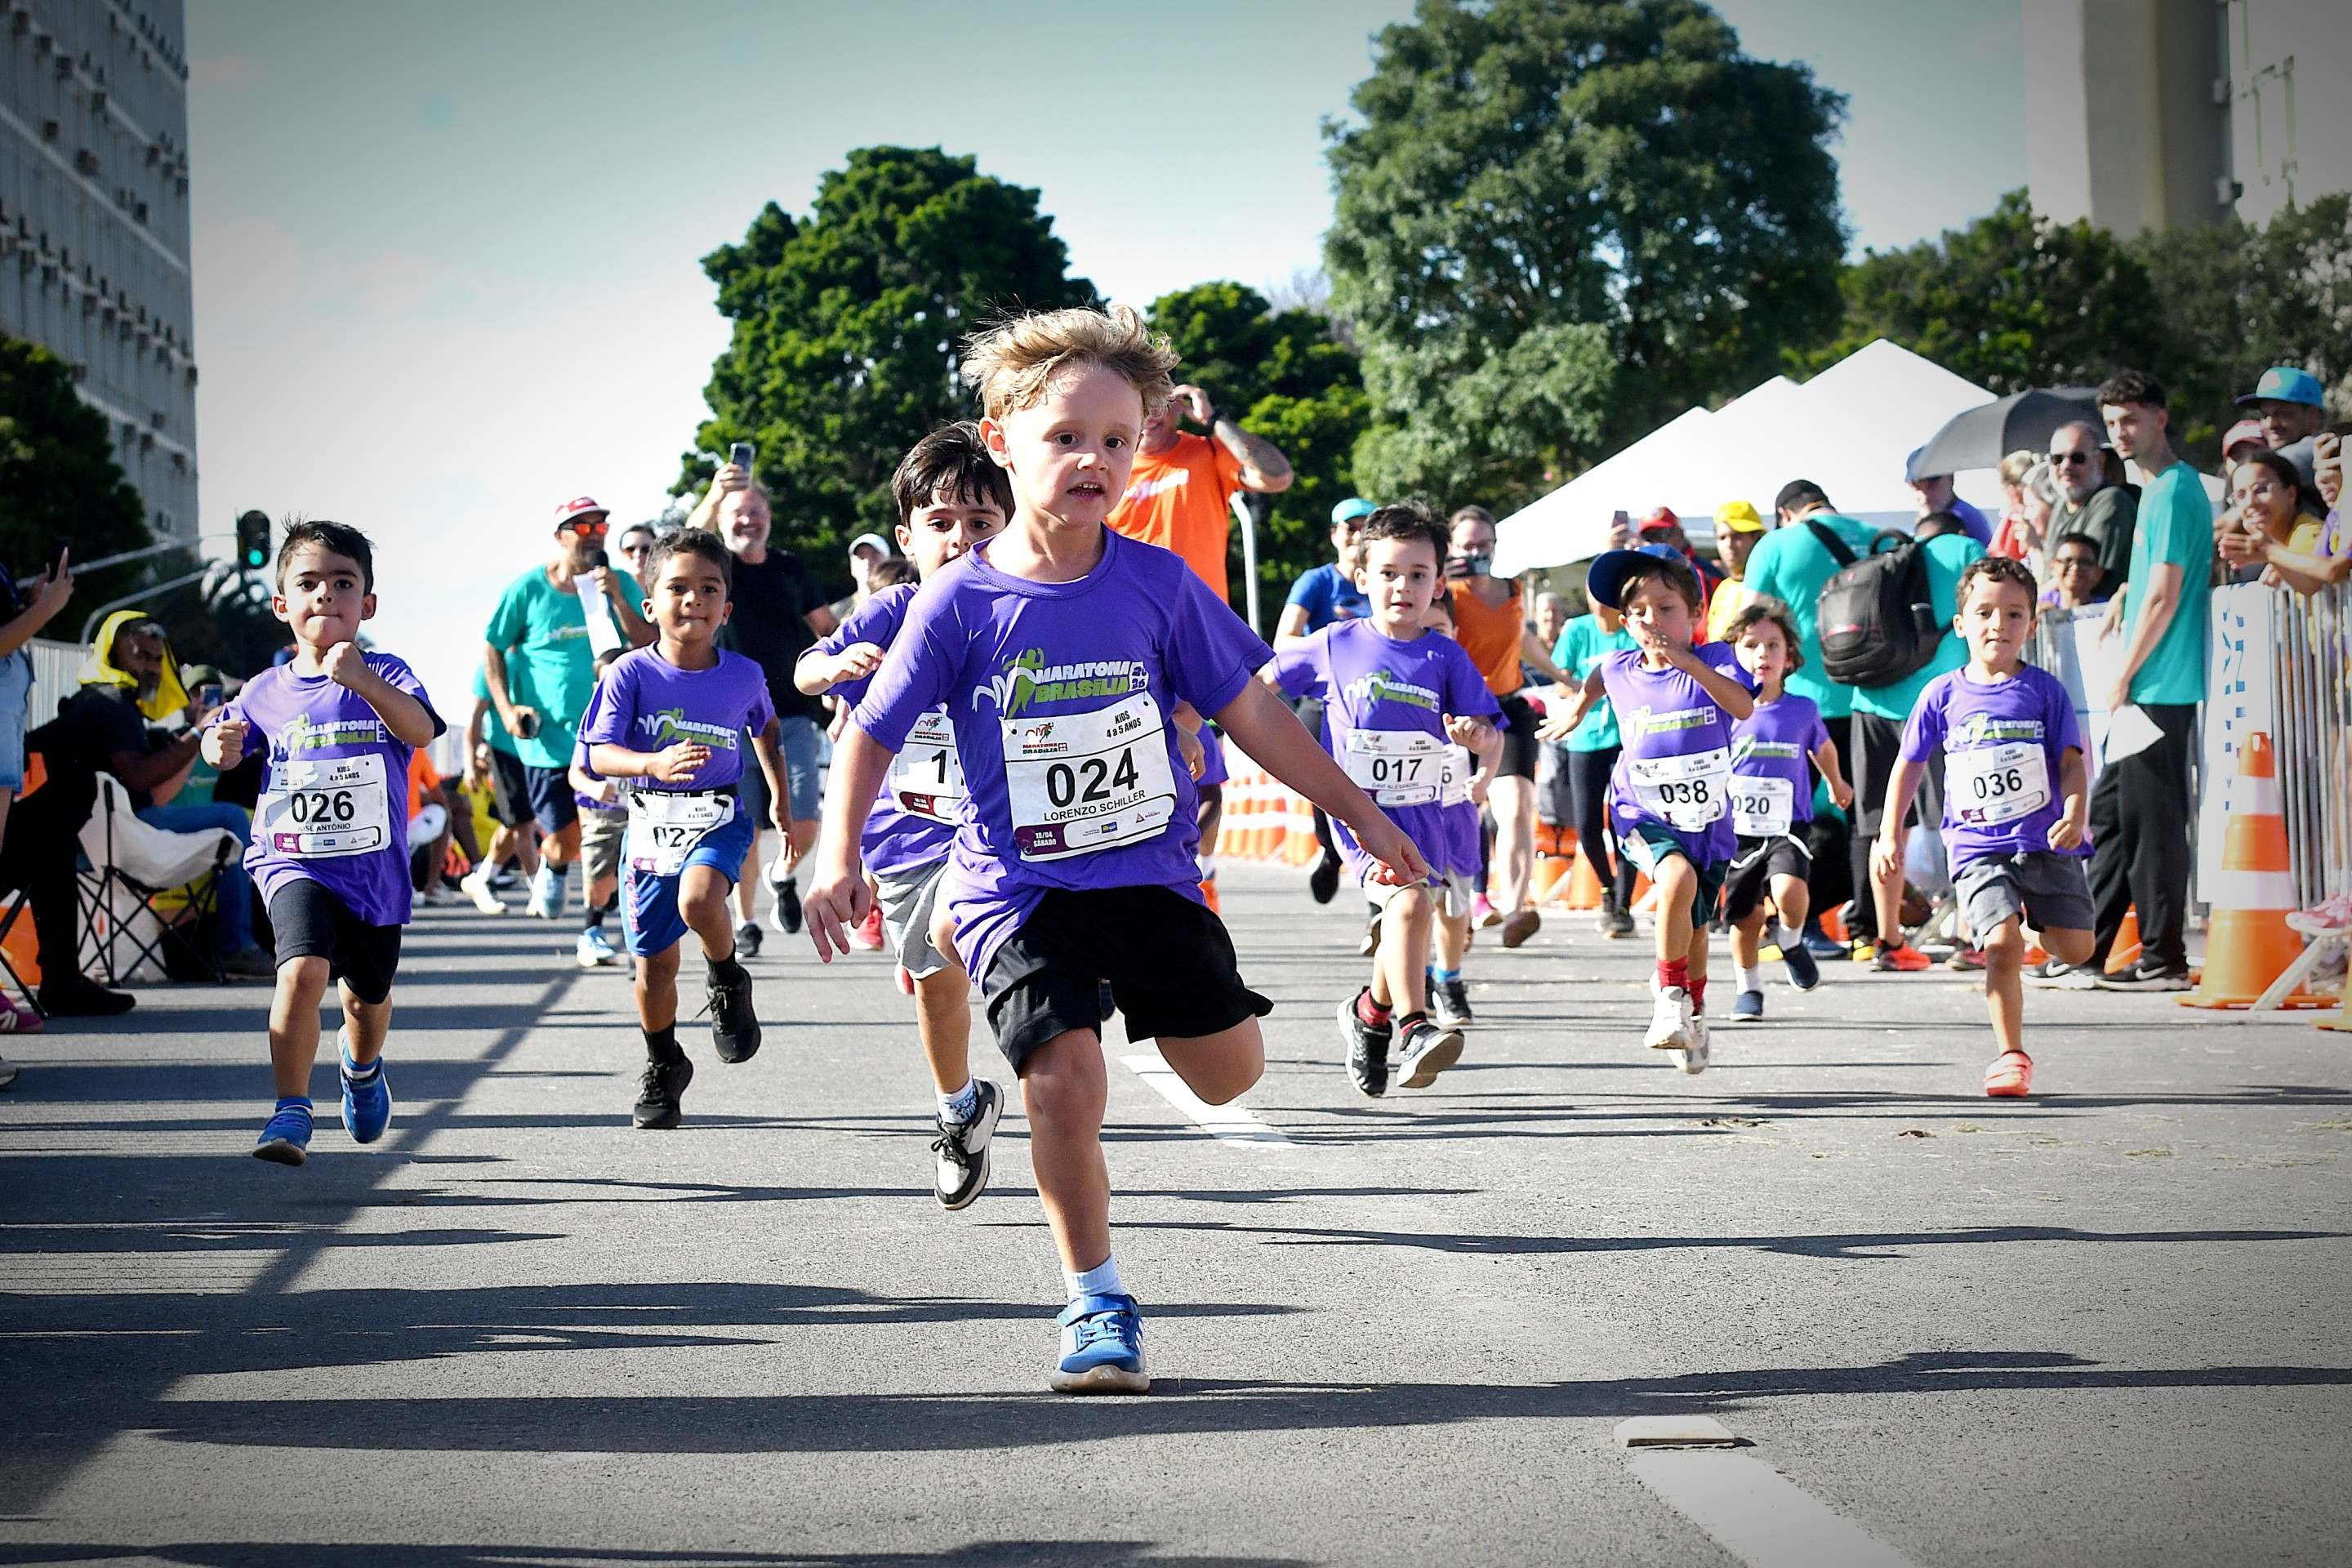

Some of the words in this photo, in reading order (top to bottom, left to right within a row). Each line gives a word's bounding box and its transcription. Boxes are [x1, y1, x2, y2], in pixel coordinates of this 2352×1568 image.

[1036, 661, 1130, 684] MARATONA
[1035, 676, 1129, 703] BRASÍLIA
[1107, 728, 1112, 737] 4
[1113, 728, 1119, 737] a
[1119, 724, 1125, 734] 5
[1125, 718, 1142, 733] ANOS
[1115, 710, 1130, 724] KIDS
[1046, 746, 1139, 808] 024
[1373, 758, 1423, 782] 017
[1659, 779, 1709, 804] 038
[1973, 768, 2023, 799] 036
[292, 790, 354, 823] 026
[1044, 805, 1097, 822] LORENZO
[1099, 790, 1146, 813] SCHILLER
[1732, 795, 1771, 815] 020
[316, 822, 351, 832] ANTÔNIO
[653, 826, 706, 848] 027
